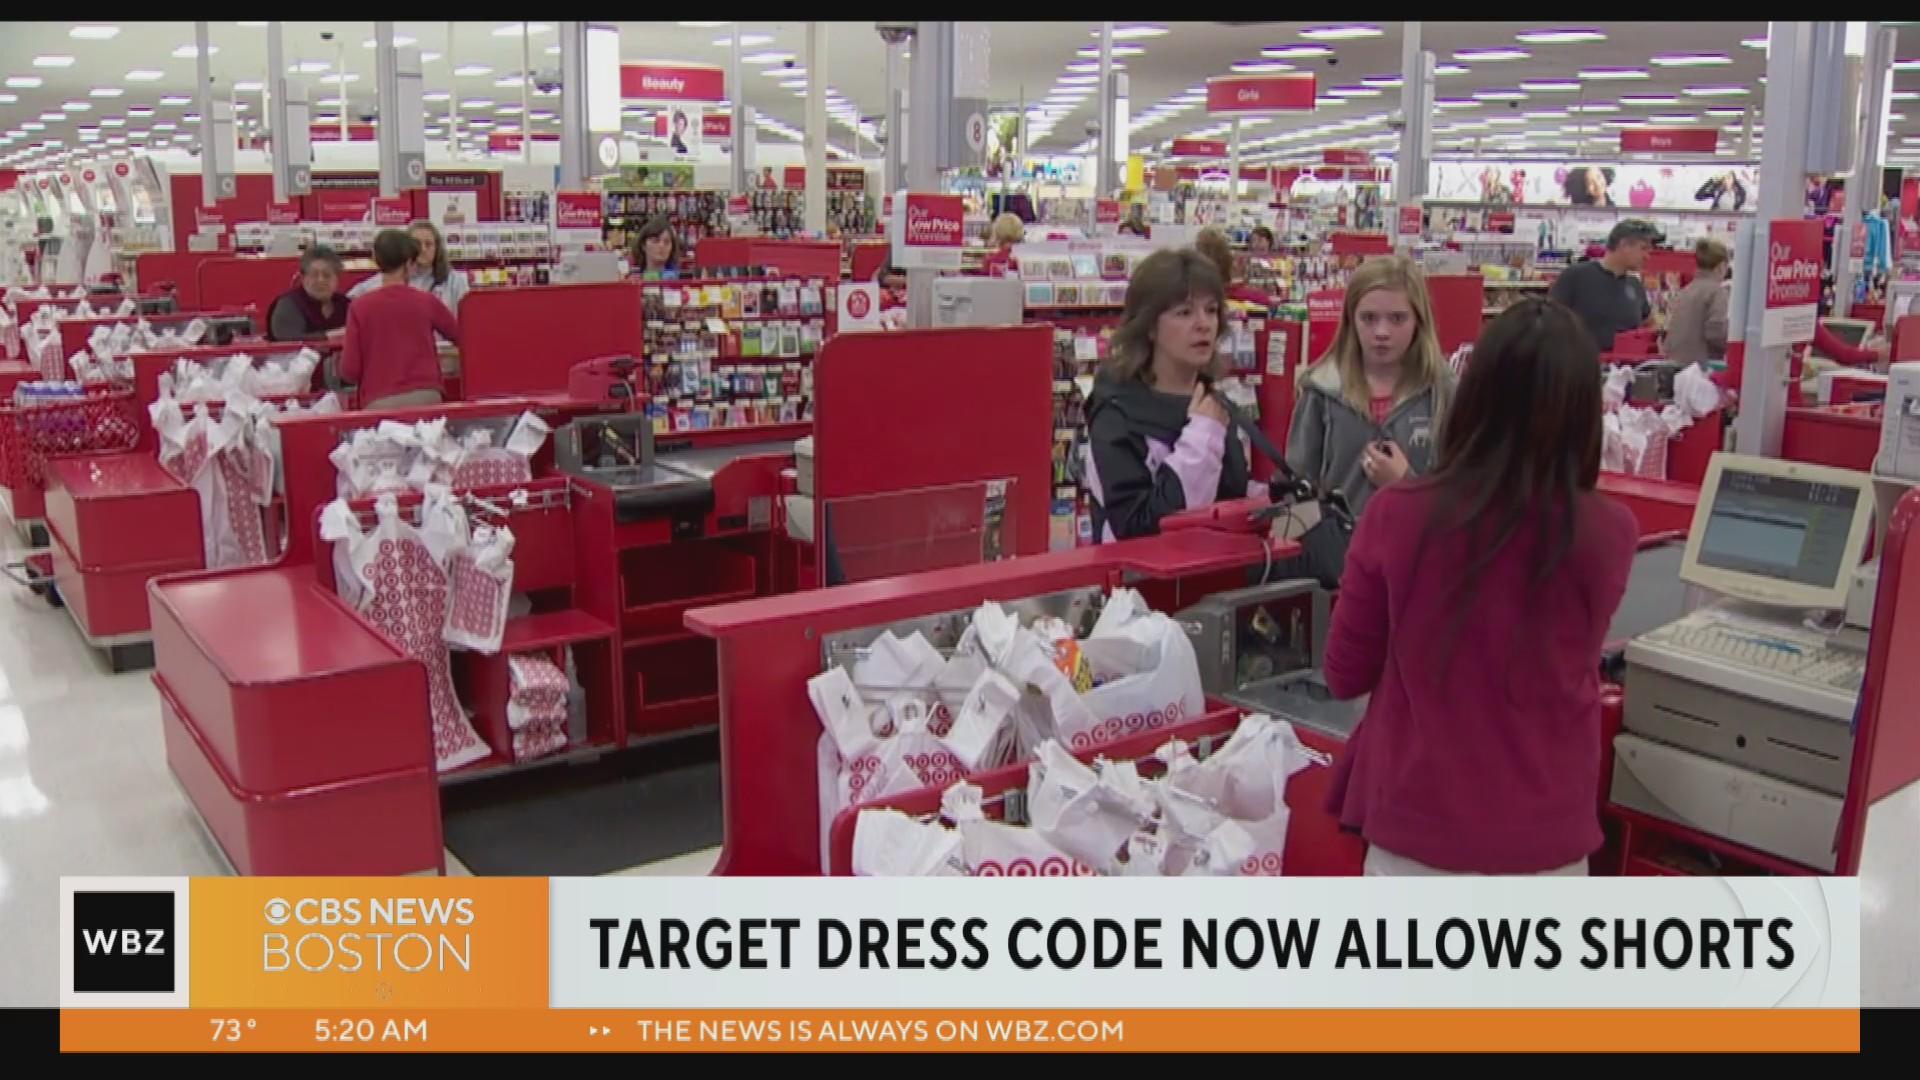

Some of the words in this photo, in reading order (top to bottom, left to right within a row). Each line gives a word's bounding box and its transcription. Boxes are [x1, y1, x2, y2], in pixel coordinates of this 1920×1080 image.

[641, 75, 685, 93] Beauty
[1237, 88, 1260, 101] Girls
[972, 120, 982, 144] 8
[604, 144, 615, 157] 10
[909, 204, 929, 217] Our
[909, 216, 931, 231] Low
[933, 217, 960, 231] Price
[1770, 241, 1792, 261] Our
[1770, 260, 1793, 281] Low
[1793, 259, 1819, 279] Price
